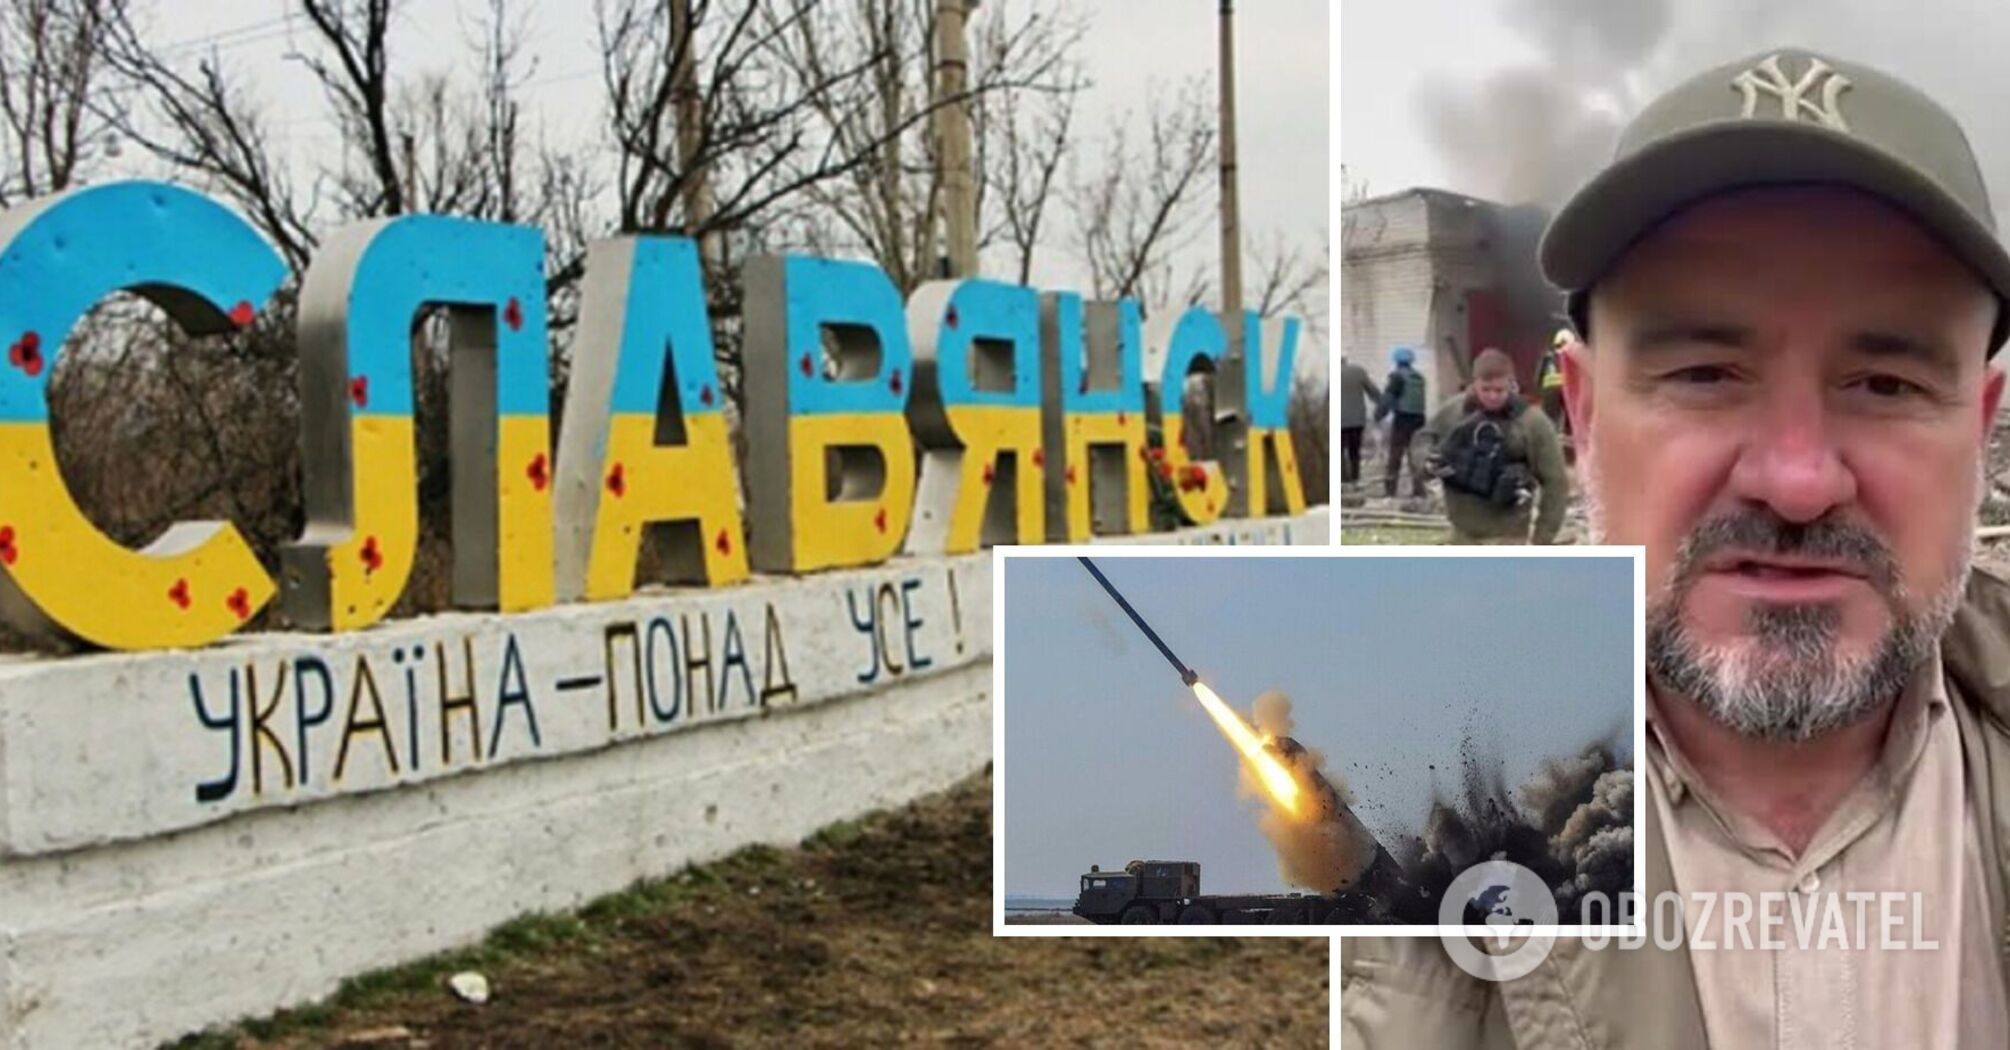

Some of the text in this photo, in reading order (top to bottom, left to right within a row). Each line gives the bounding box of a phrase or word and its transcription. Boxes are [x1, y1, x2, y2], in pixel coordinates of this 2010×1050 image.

[1732, 55, 1851, 134] NY
[0, 178, 1305, 651] СЛАВЯНСК
[189, 633, 541, 802] УКРАЇНА
